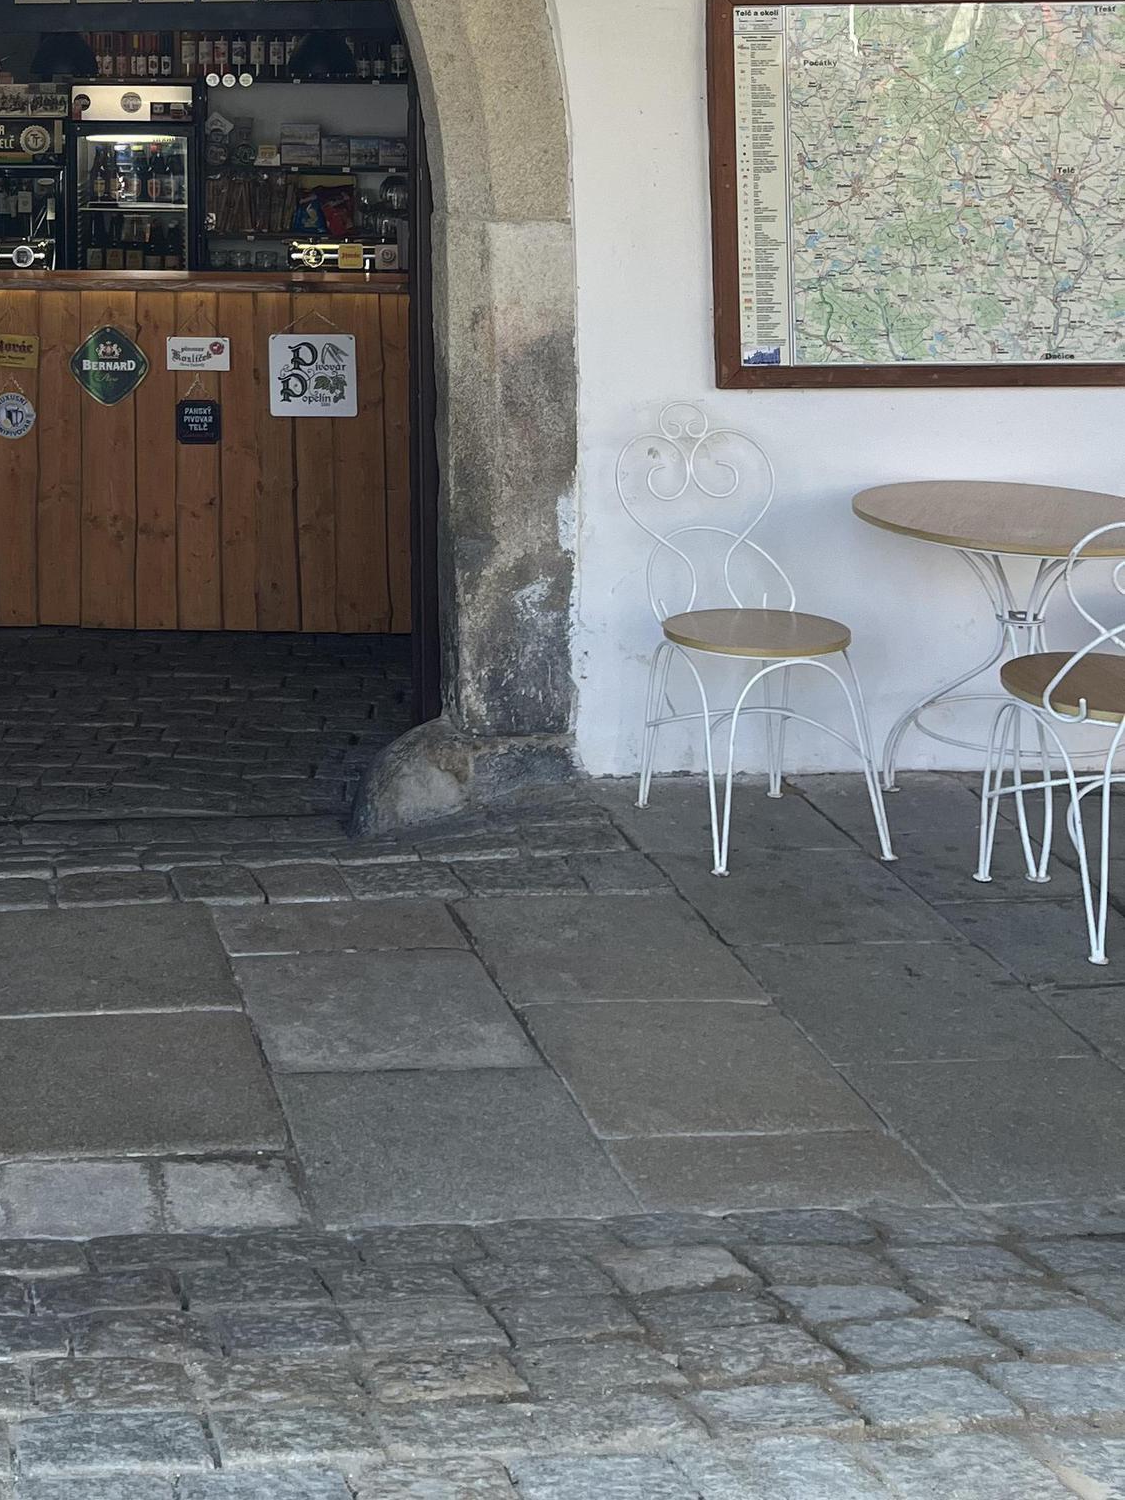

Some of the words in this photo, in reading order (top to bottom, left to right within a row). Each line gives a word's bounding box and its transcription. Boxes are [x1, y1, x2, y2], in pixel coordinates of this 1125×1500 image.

[803, 59, 838, 67] Počátky
[1057, 166, 1075, 174] Telč
[288, 341, 347, 371] Pivovar
[82, 359, 137, 371] BERNARD
[278, 373, 332, 404] Popelín
[184, 405, 212, 415] PANSKÝ
[183, 415, 213, 423] PIVOVAR
[188, 422, 209, 431] TELČ
